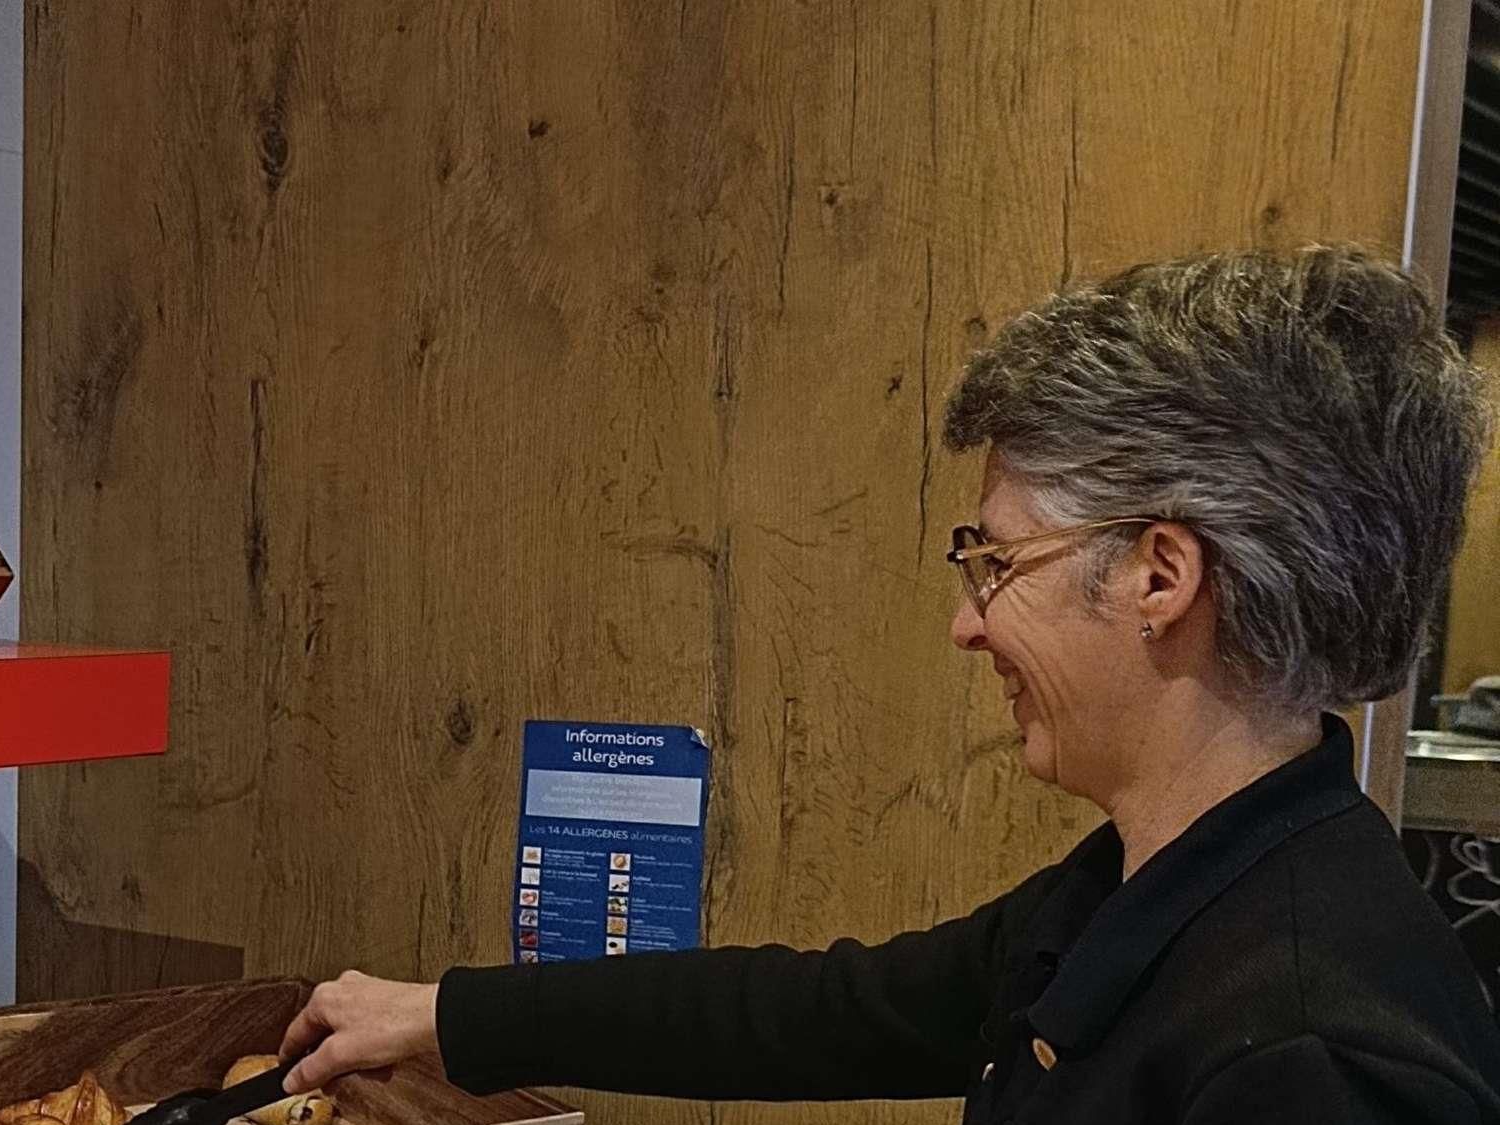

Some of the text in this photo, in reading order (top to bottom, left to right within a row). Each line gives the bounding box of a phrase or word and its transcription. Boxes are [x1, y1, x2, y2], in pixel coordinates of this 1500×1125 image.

[566, 729, 665, 746] Informations
[572, 748, 654, 768] allergènes
[548, 825, 560, 834] 14
